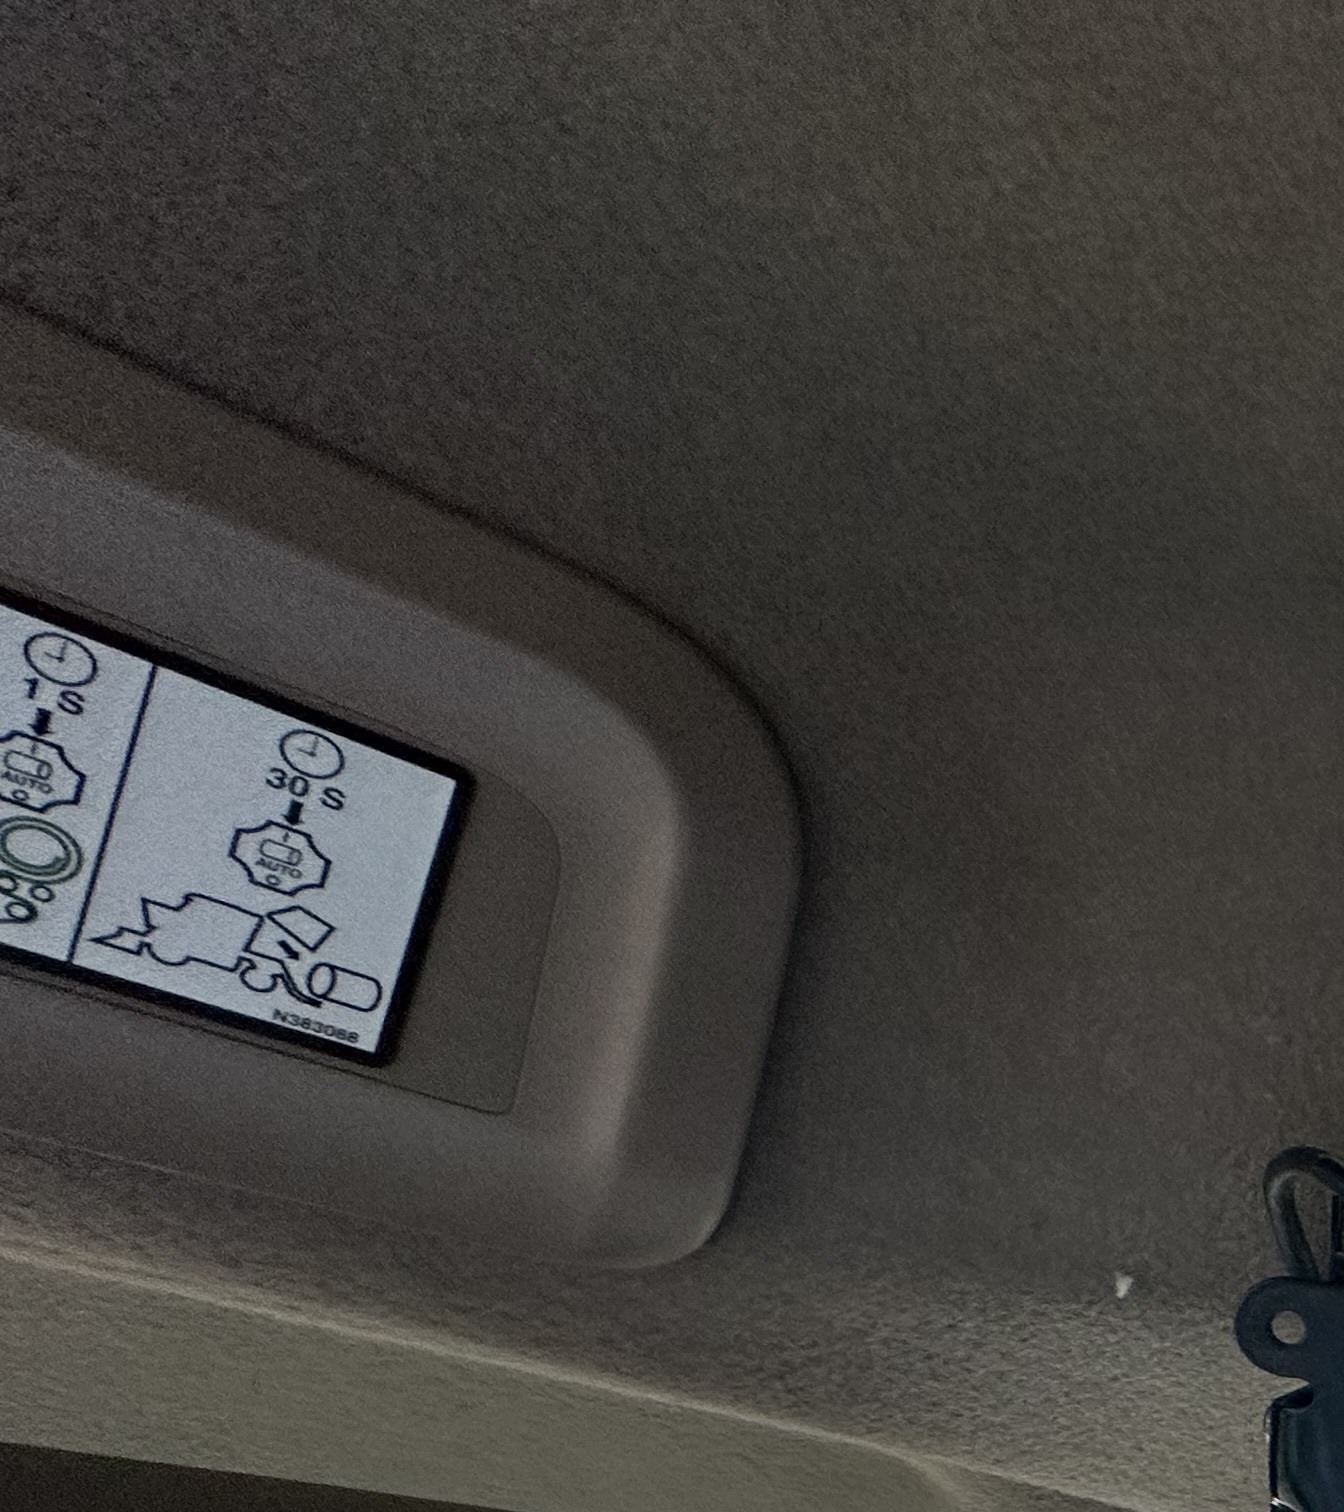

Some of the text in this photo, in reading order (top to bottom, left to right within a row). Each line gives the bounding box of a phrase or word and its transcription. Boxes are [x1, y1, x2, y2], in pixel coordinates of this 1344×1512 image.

[24, 677, 85, 715] 1 S
[265, 767, 347, 811] 30 S
[255, 857, 303, 879] AUTO
